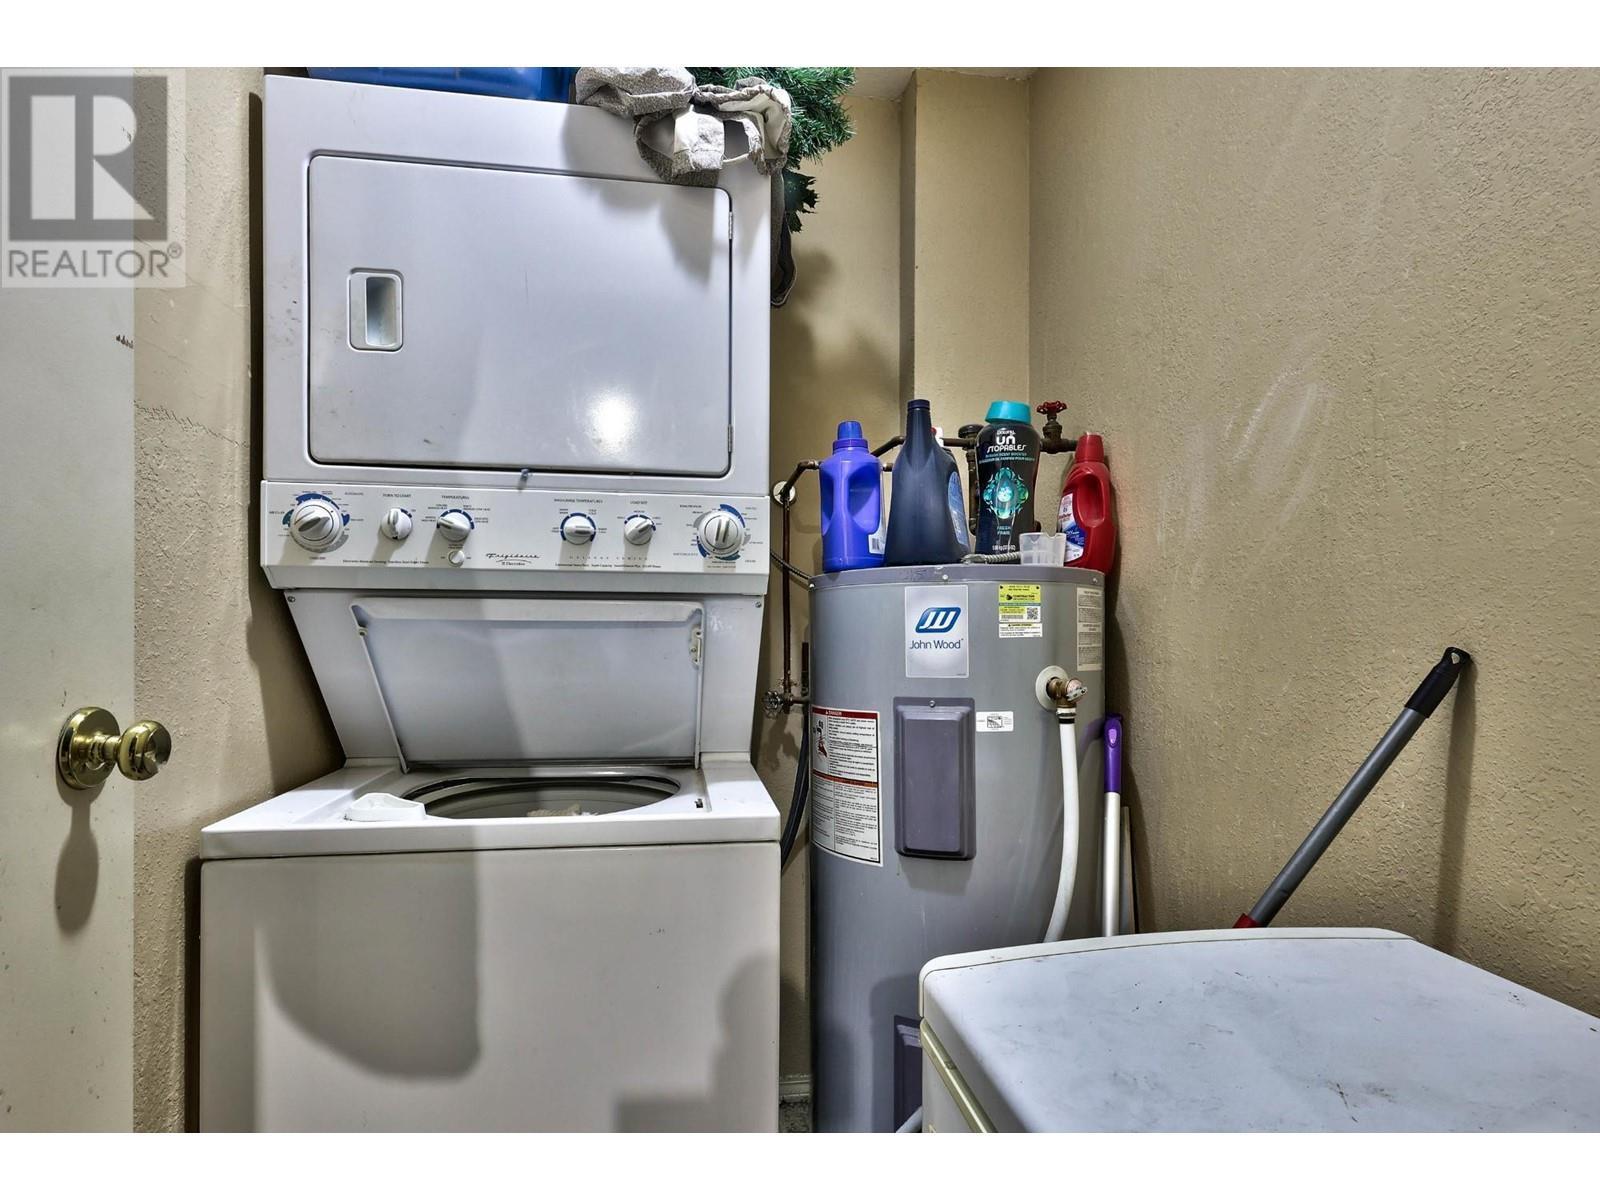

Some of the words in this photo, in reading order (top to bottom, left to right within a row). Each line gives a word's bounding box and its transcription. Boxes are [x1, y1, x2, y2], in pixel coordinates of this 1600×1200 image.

[986, 444, 1027, 454] STOPABLES
[909, 639, 932, 649] John
[934, 639, 962, 649] Wood
